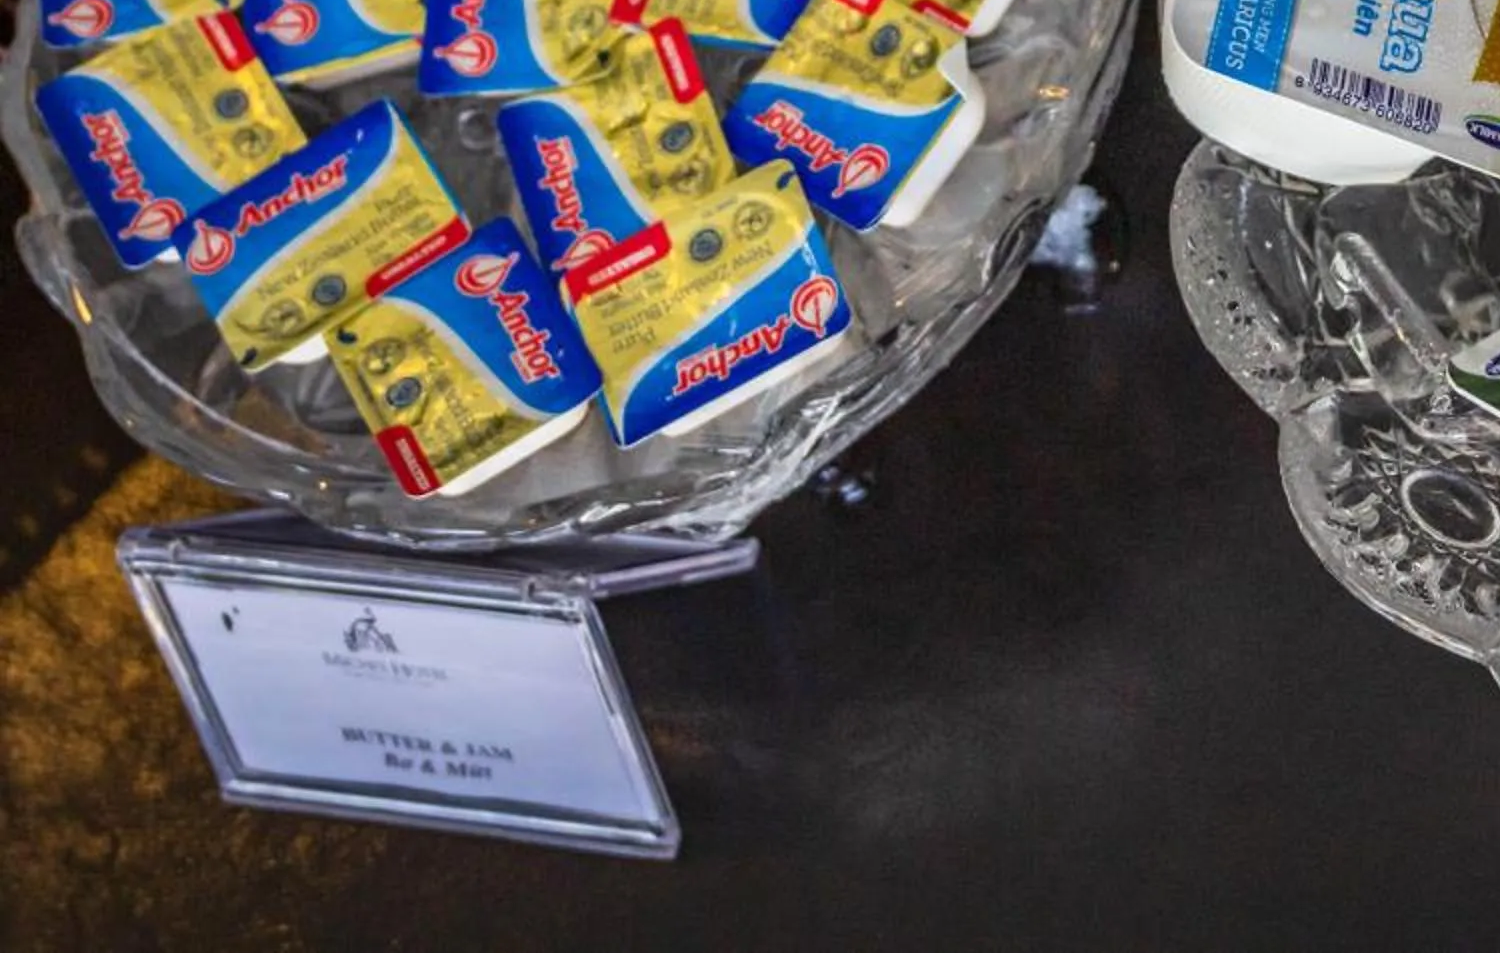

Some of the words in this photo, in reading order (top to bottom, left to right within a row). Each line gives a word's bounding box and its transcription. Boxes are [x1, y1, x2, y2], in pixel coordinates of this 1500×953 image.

[1252, 16, 1272, 54] MEN
[84, 111, 150, 203] Anchor
[756, 103, 846, 172] Anchor
[236, 155, 349, 236] Anchor
[539, 137, 584, 231] Anchor
[493, 290, 559, 382] Anchor
[674, 311, 787, 396] Anchor
[440, 739, 458, 755] &
